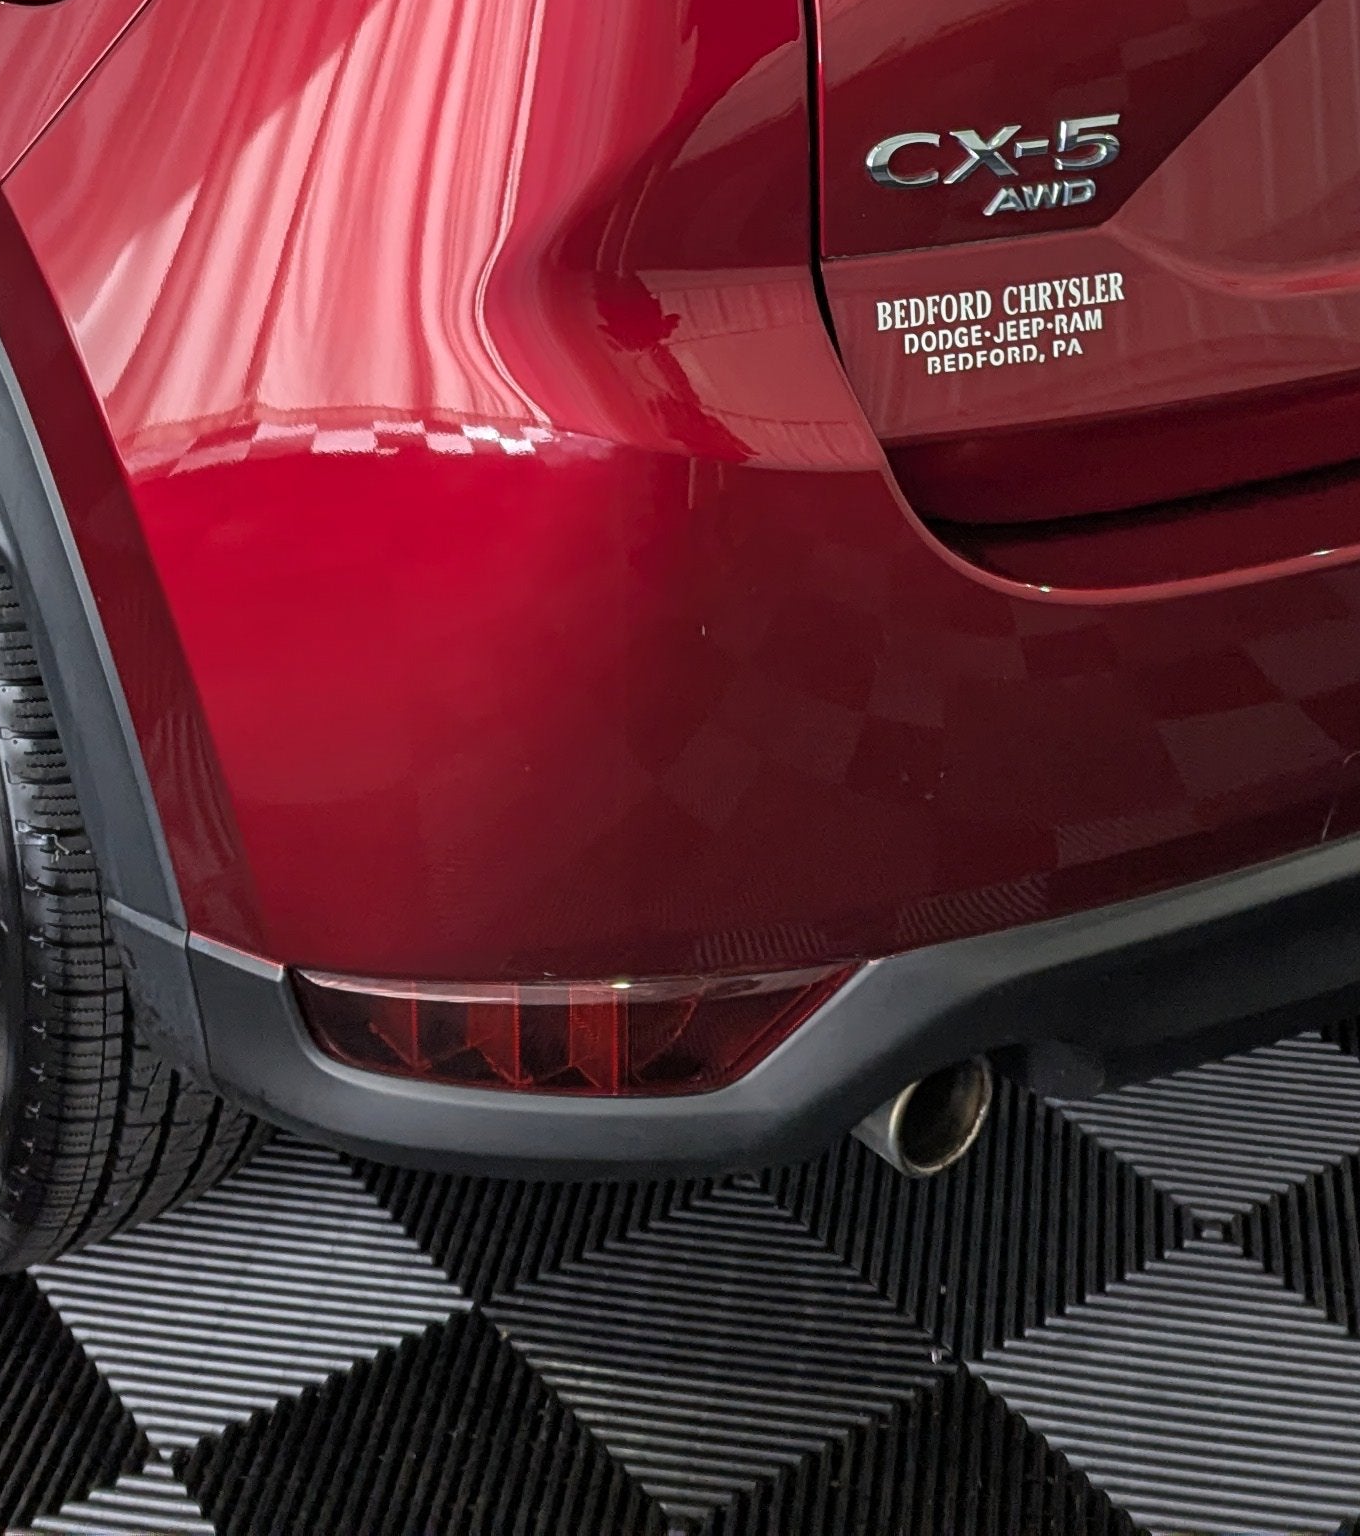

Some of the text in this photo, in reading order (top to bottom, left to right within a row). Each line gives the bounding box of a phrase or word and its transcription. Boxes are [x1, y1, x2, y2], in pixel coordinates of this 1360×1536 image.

[865, 113, 1121, 190] CX-5
[982, 177, 1096, 217] AWD
[876, 272, 1126, 332] BEDFORD CHRYSLER
[1052, 338, 1084, 358] PA
